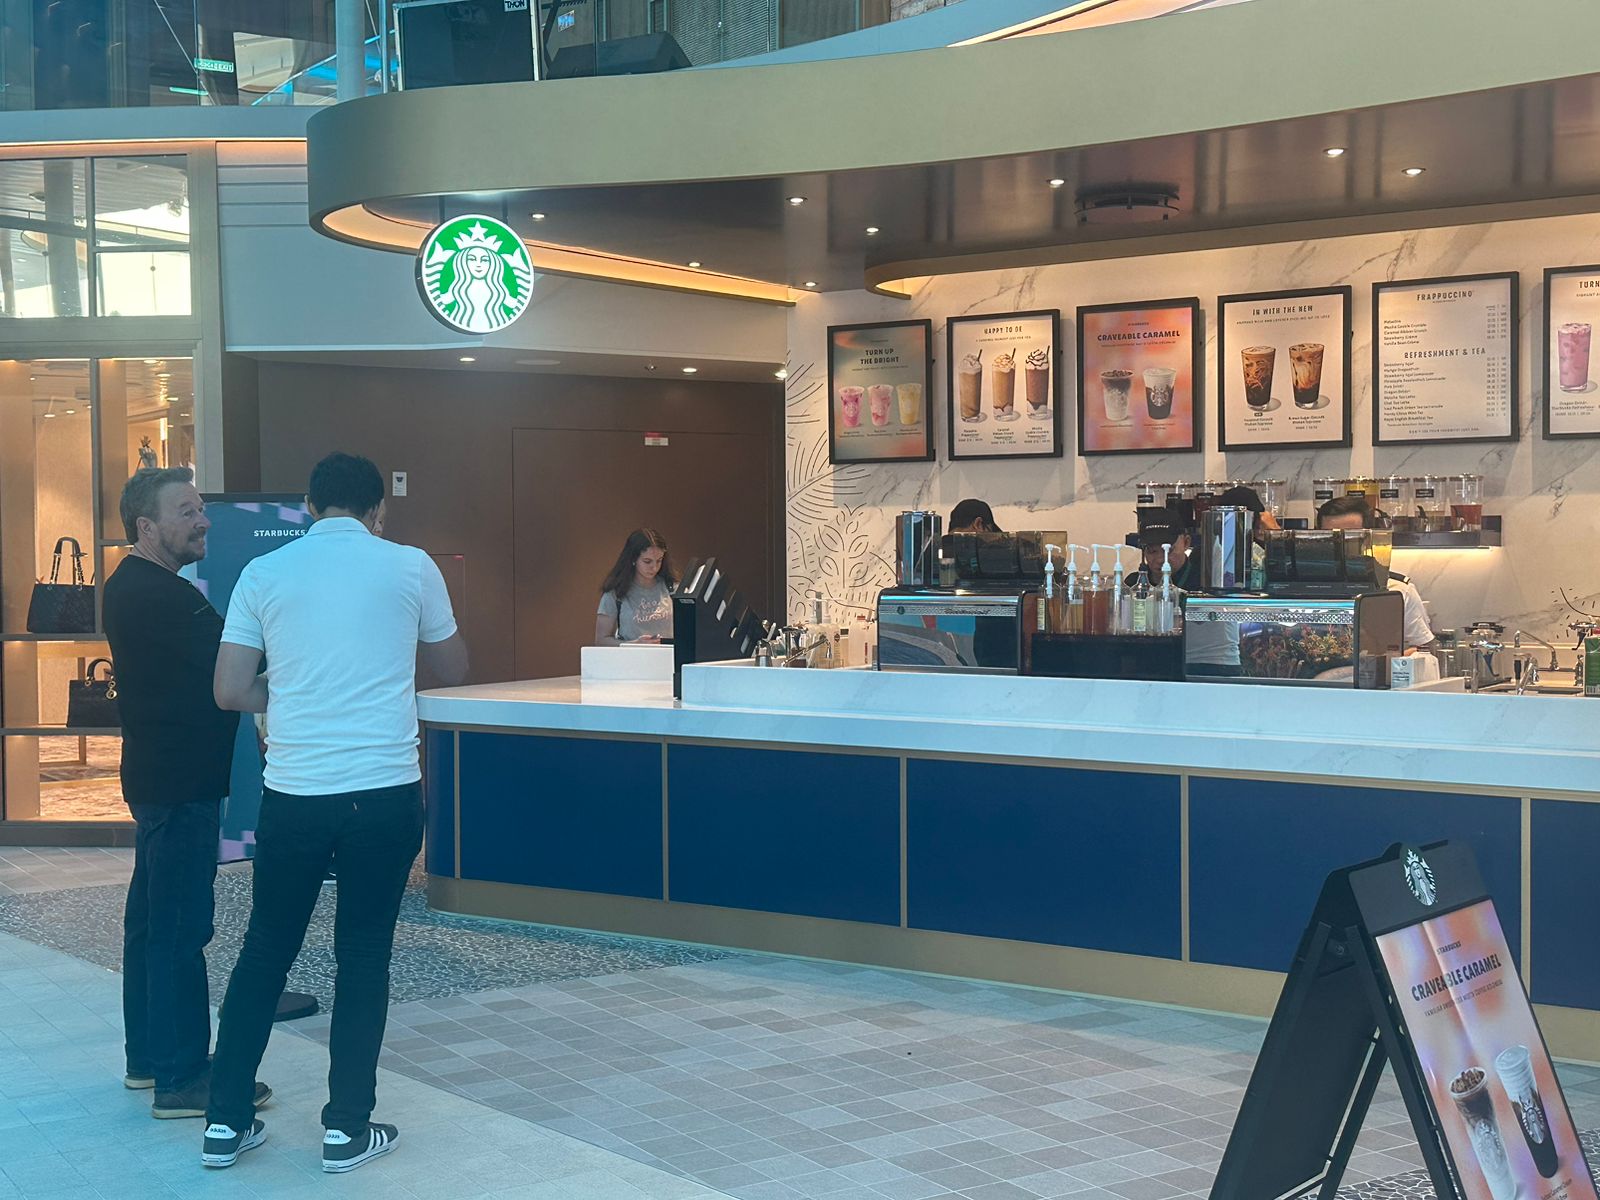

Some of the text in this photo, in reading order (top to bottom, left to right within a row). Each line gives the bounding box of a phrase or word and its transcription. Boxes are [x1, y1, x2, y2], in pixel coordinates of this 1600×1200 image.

[504, 0, 525, 8] THON
[1416, 290, 1472, 301] FRAPPUCCINO
[1263, 307, 1280, 315] WITH
[1098, 332, 1140, 341] CRAVEABLE
[1404, 349, 1459, 359] REFRESHMENT
[1437, 940, 1462, 955] STARBUCKS
[1411, 968, 1464, 1002] CRAVEABLE
[1462, 953, 1502, 981] CARAMEL
